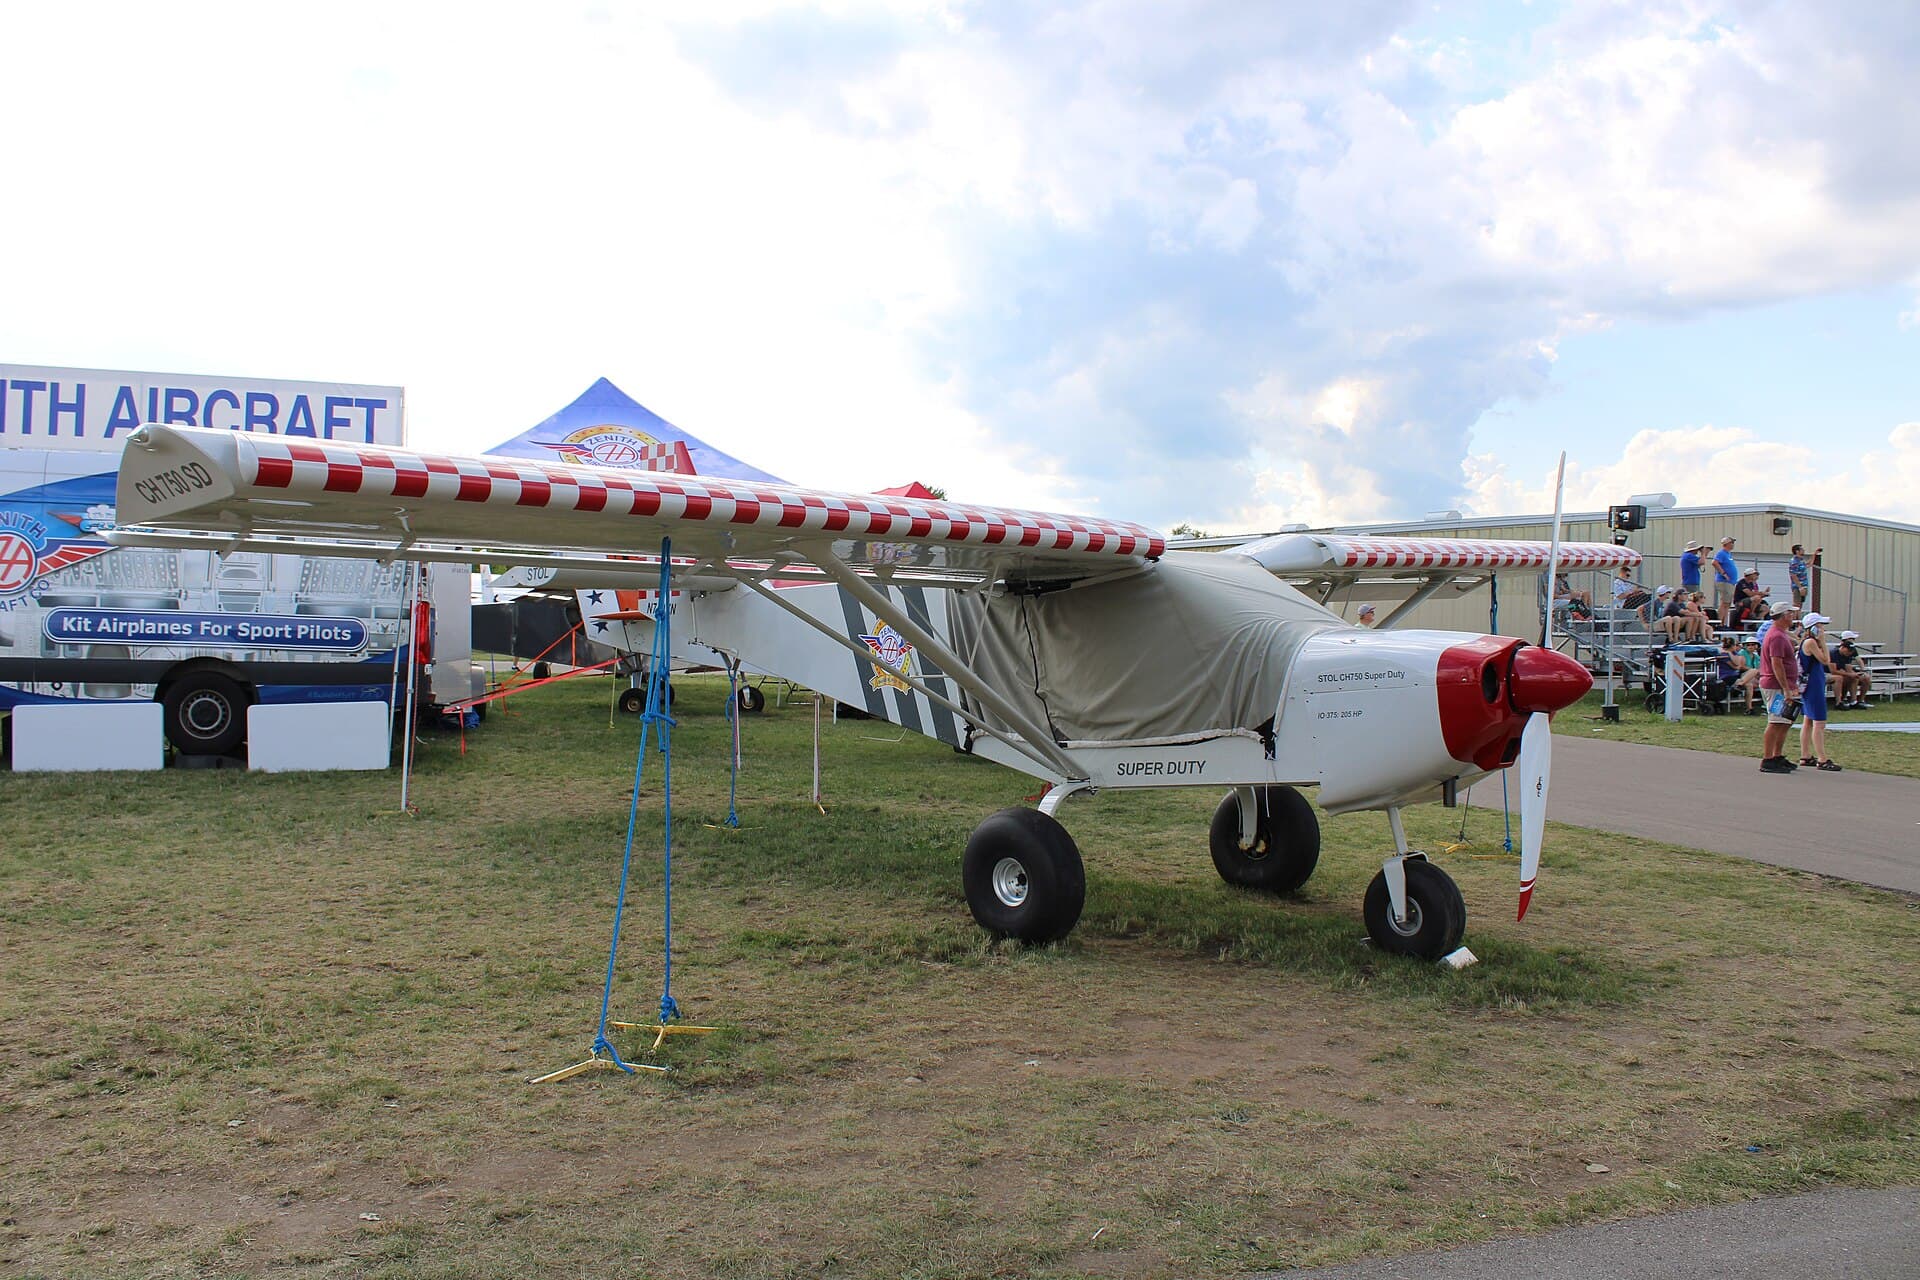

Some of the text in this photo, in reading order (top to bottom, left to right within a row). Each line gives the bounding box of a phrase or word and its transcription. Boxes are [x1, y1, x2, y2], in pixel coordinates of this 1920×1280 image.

[104, 385, 388, 444] AIRCRAFT
[590, 435, 638, 446] ZENITH
[135, 462, 213, 504] CH 750 SD
[527, 567, 549, 581] STOL
[62, 616, 351, 641] Kit Airplanes For Sport Pilots
[1317, 670, 1406, 682] STOL CH750 Super Duty
[1352, 710, 1363, 718] HP
[1117, 760, 1207, 776] SUPER DUTY
